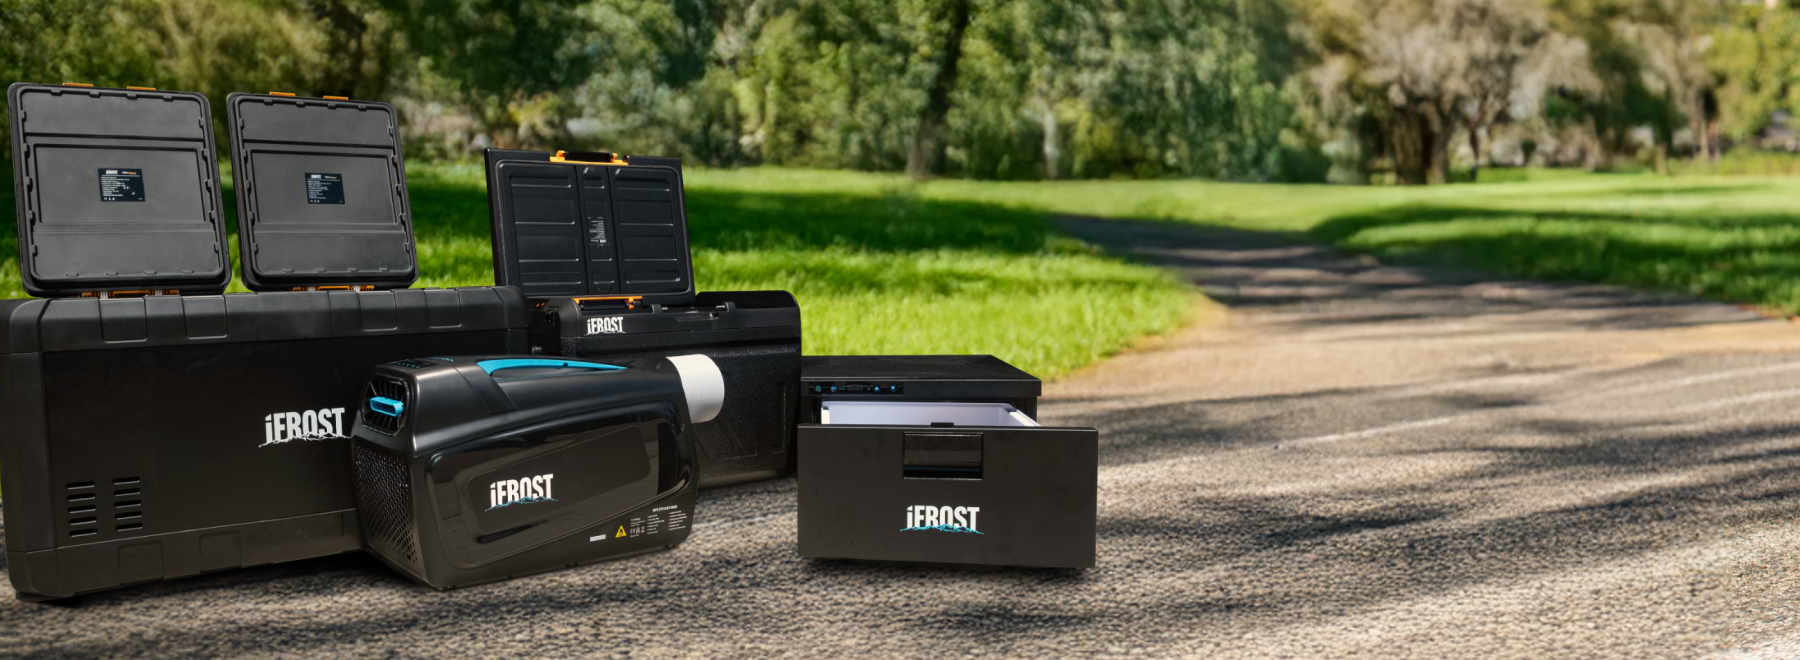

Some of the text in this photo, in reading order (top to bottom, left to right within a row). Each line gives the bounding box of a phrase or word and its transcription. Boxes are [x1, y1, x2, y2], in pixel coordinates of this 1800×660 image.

[265, 407, 345, 443] iFROST
[490, 473, 553, 508] iFROST
[906, 505, 980, 531] iFROST
